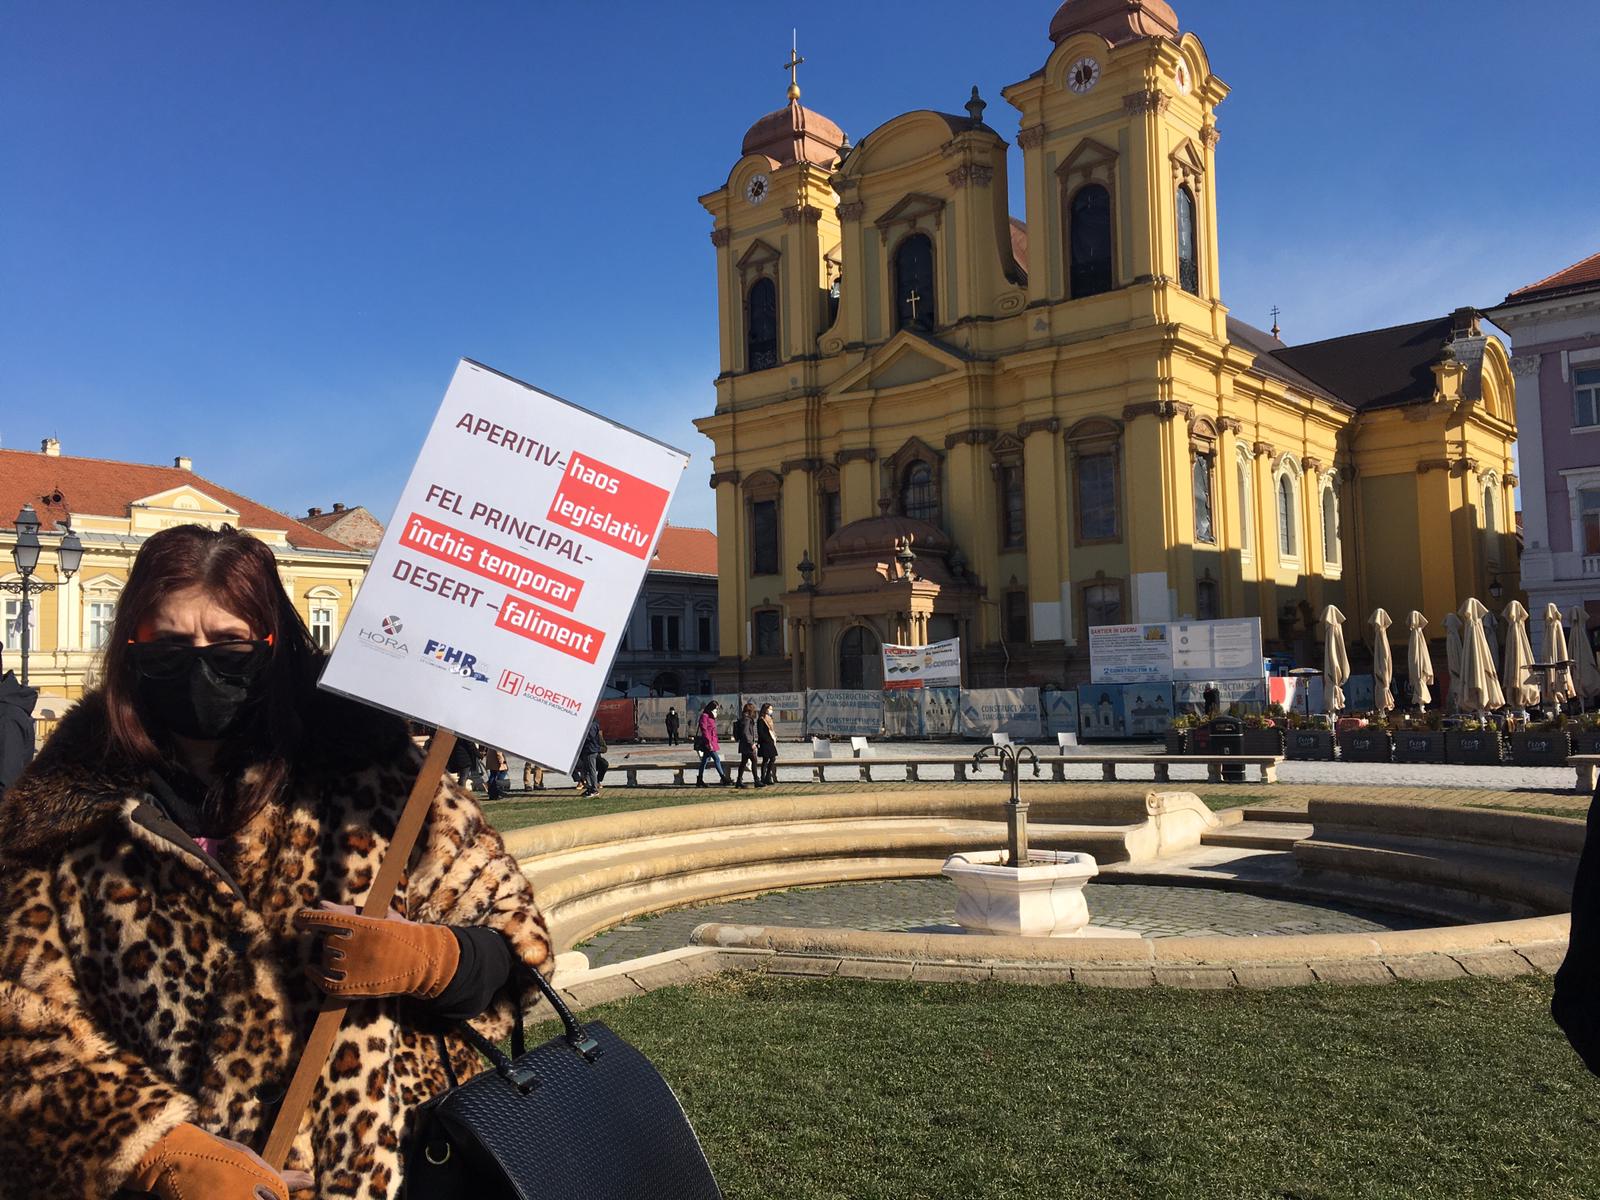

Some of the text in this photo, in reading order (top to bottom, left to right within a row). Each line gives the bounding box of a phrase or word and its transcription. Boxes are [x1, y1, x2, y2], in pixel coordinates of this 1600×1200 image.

[570, 457, 620, 495] haos
[425, 483, 594, 565] FEL PRINCIPAL-
[553, 492, 650, 548] legislativ
[407, 518, 576, 602] închis temporar
[392, 559, 484, 608] DESERT
[502, 600, 594, 654] faliment
[358, 628, 409, 654] HORA
[524, 682, 583, 712] HORETIM
